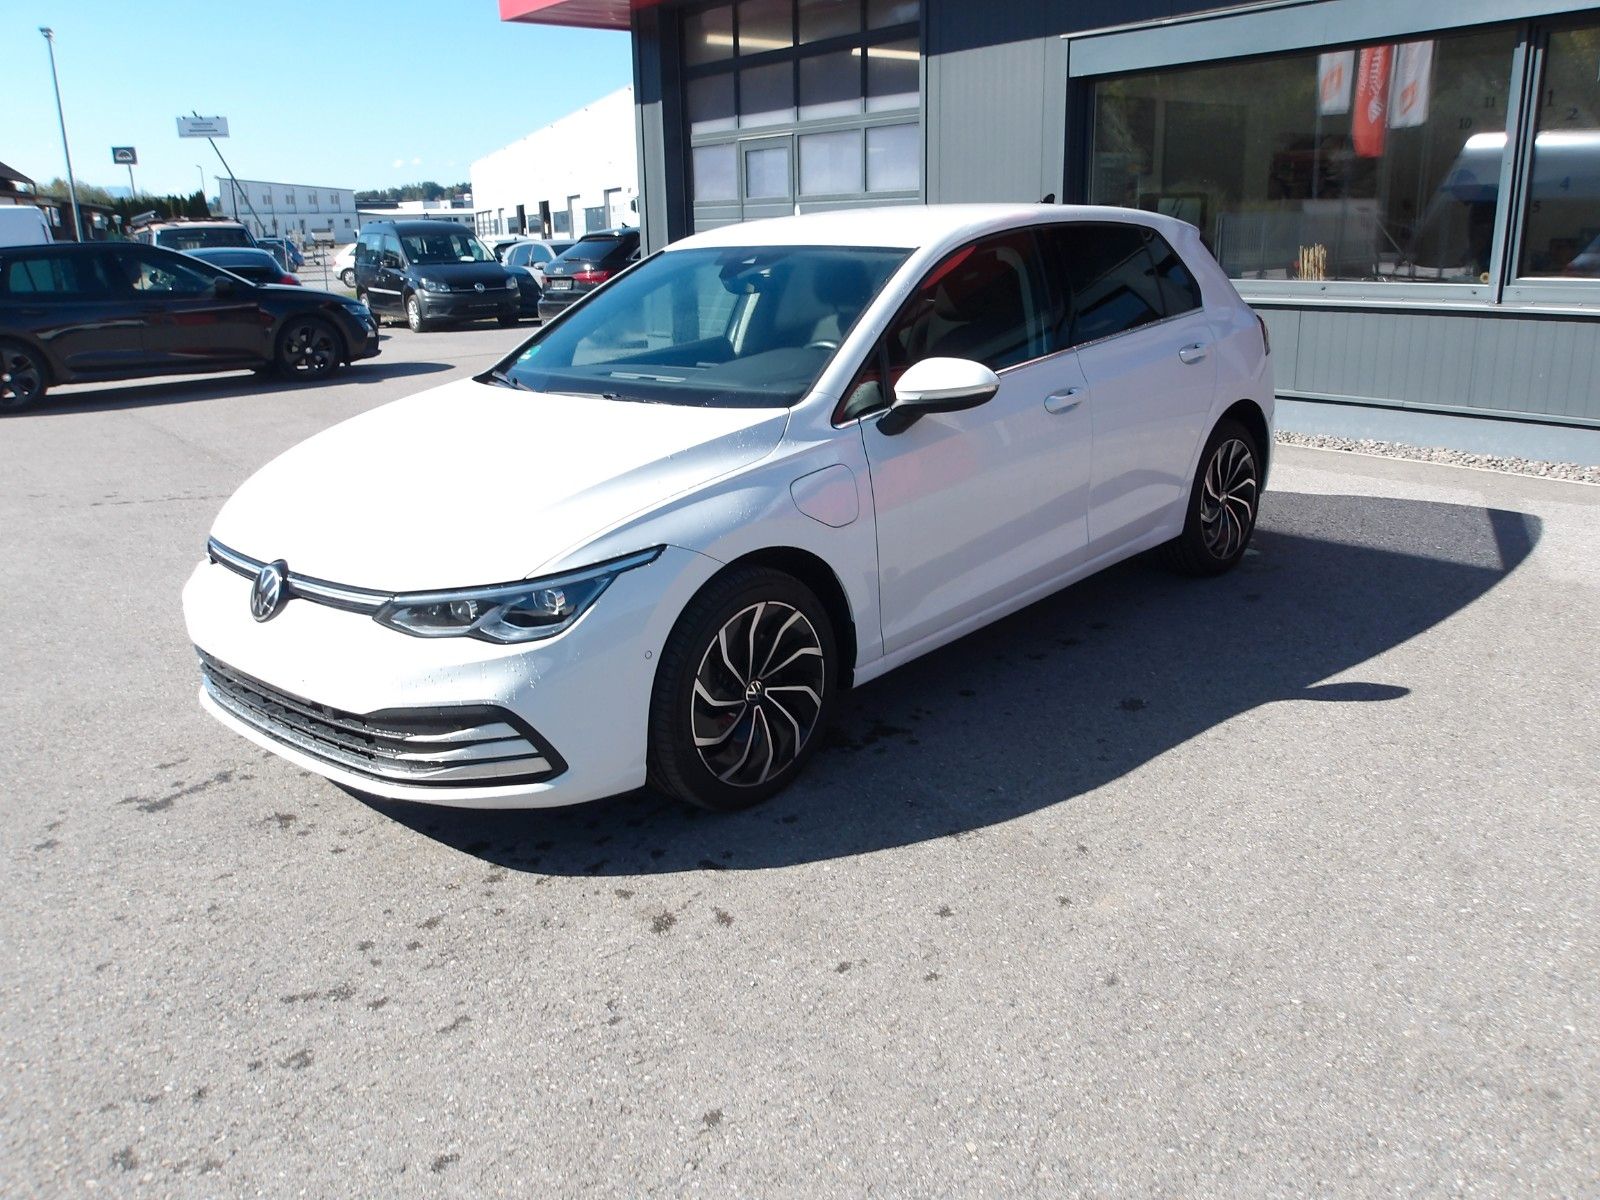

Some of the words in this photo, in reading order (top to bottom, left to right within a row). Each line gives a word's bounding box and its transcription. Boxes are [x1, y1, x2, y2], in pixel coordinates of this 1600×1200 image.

[1459, 118, 1471, 129] 10
[1560, 177, 1570, 191] 4
[253, 565, 280, 620] VW
